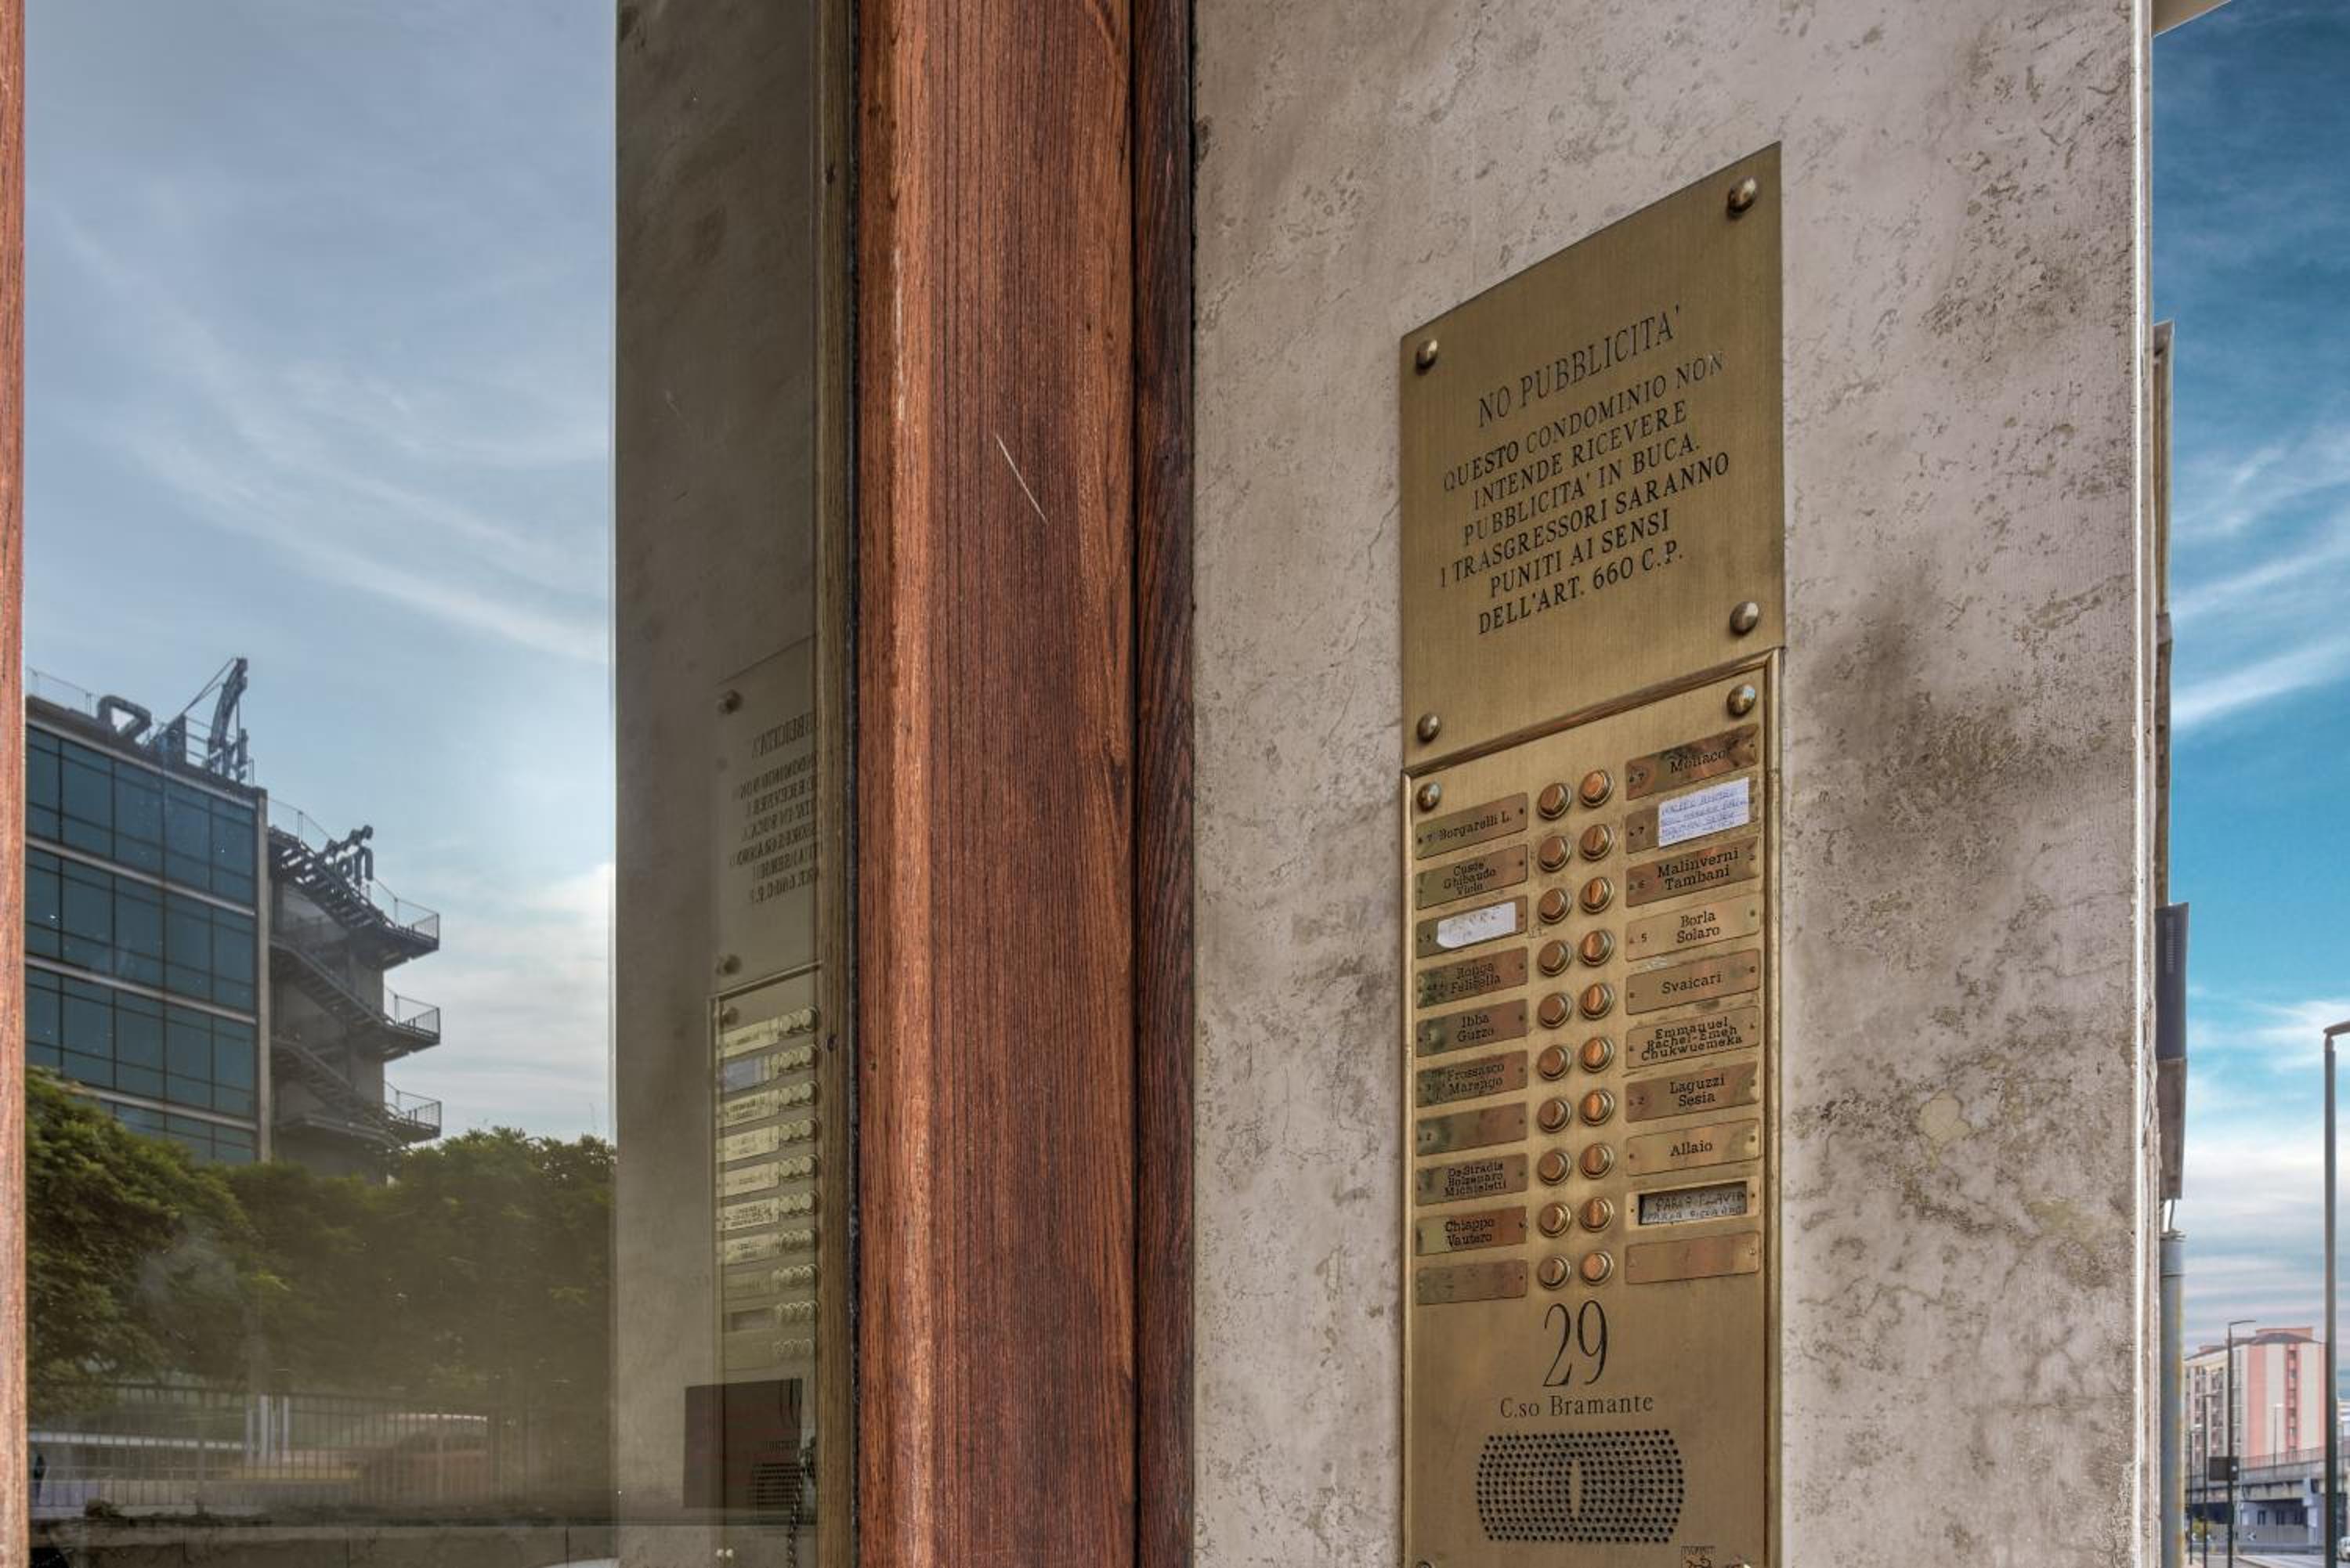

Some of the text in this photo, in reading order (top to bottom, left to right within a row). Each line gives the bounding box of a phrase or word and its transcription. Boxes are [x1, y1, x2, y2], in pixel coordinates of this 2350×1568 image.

[1479, 305, 1679, 428] NO PUBBLICITA'
[1443, 352, 1724, 492] QUESTO CONDOMINIO NON
[1473, 400, 1687, 511] INTENDE RICEVERE
[1598, 462, 1622, 489] IN
[1632, 432, 1700, 475] BUCA.
[1441, 451, 1730, 588] I TRASGRESSORI SARANNO
[1490, 508, 1669, 598] PUNITI AI SENSI
[1478, 539, 1683, 635] DELL'ART. 660 C.P.
[1658, 847, 1739, 878] Malinverni
[1665, 864, 1730, 890] Tambani
[1676, 926, 1720, 944] Solaro
[1680, 911, 1716, 928] Borla
[1641, 1035, 1743, 1061] Chukwuemeka
[1669, 1074, 1726, 1094] Laguzzi
[1679, 1093, 1716, 1107] Sesia
[1669, 1140, 1714, 1157] Allaio
[1542, 1299, 1607, 1387] 29
[1499, 1394, 1654, 1418] C.so Bramante
